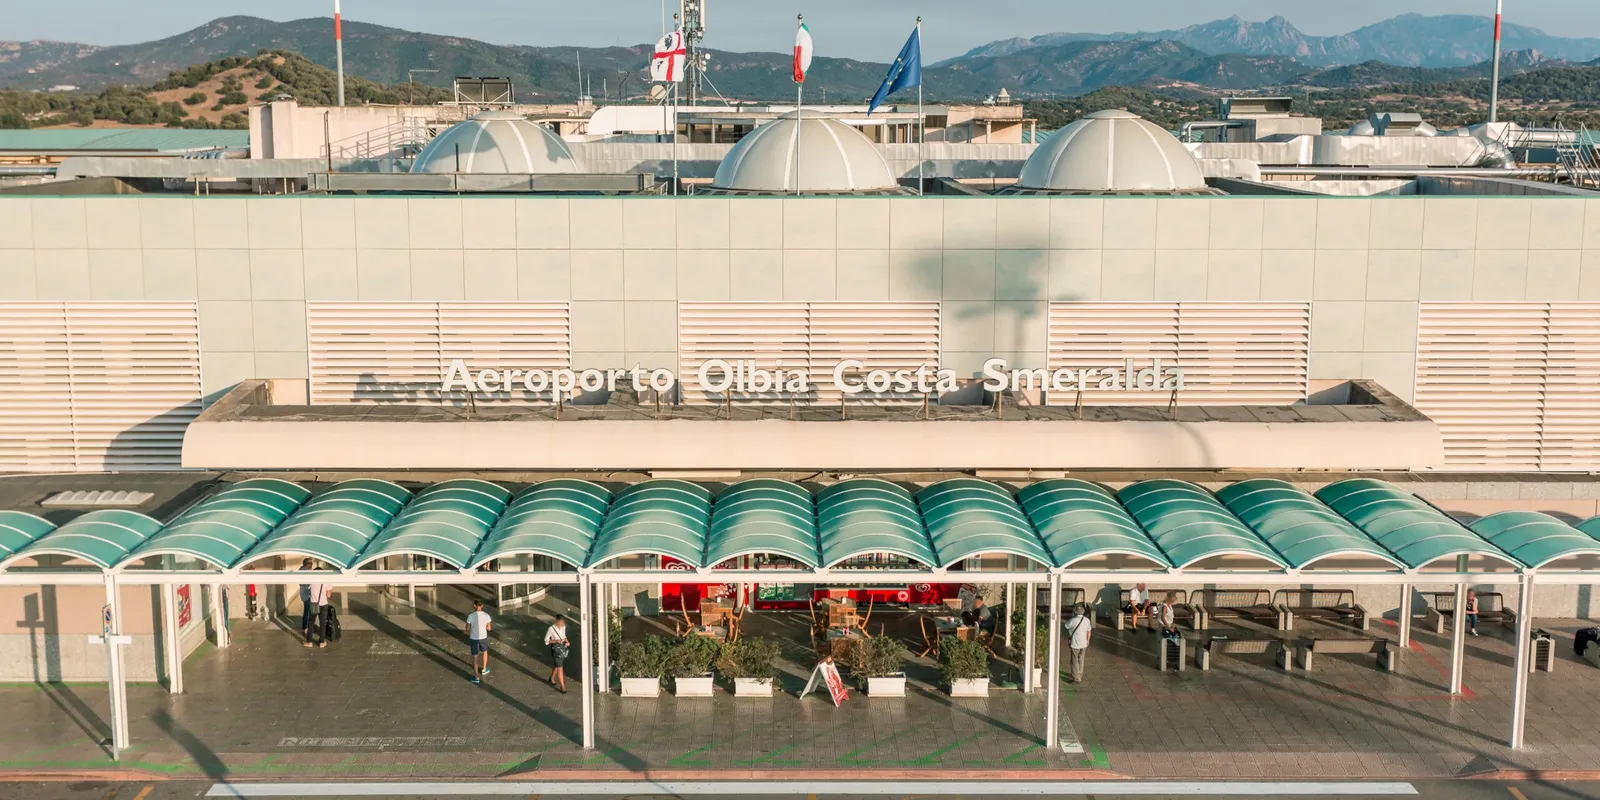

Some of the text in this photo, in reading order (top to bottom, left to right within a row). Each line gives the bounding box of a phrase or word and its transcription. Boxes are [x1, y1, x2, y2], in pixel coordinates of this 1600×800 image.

[441, 357, 1187, 401] Aeroporto Olbia Costa Smeralda
